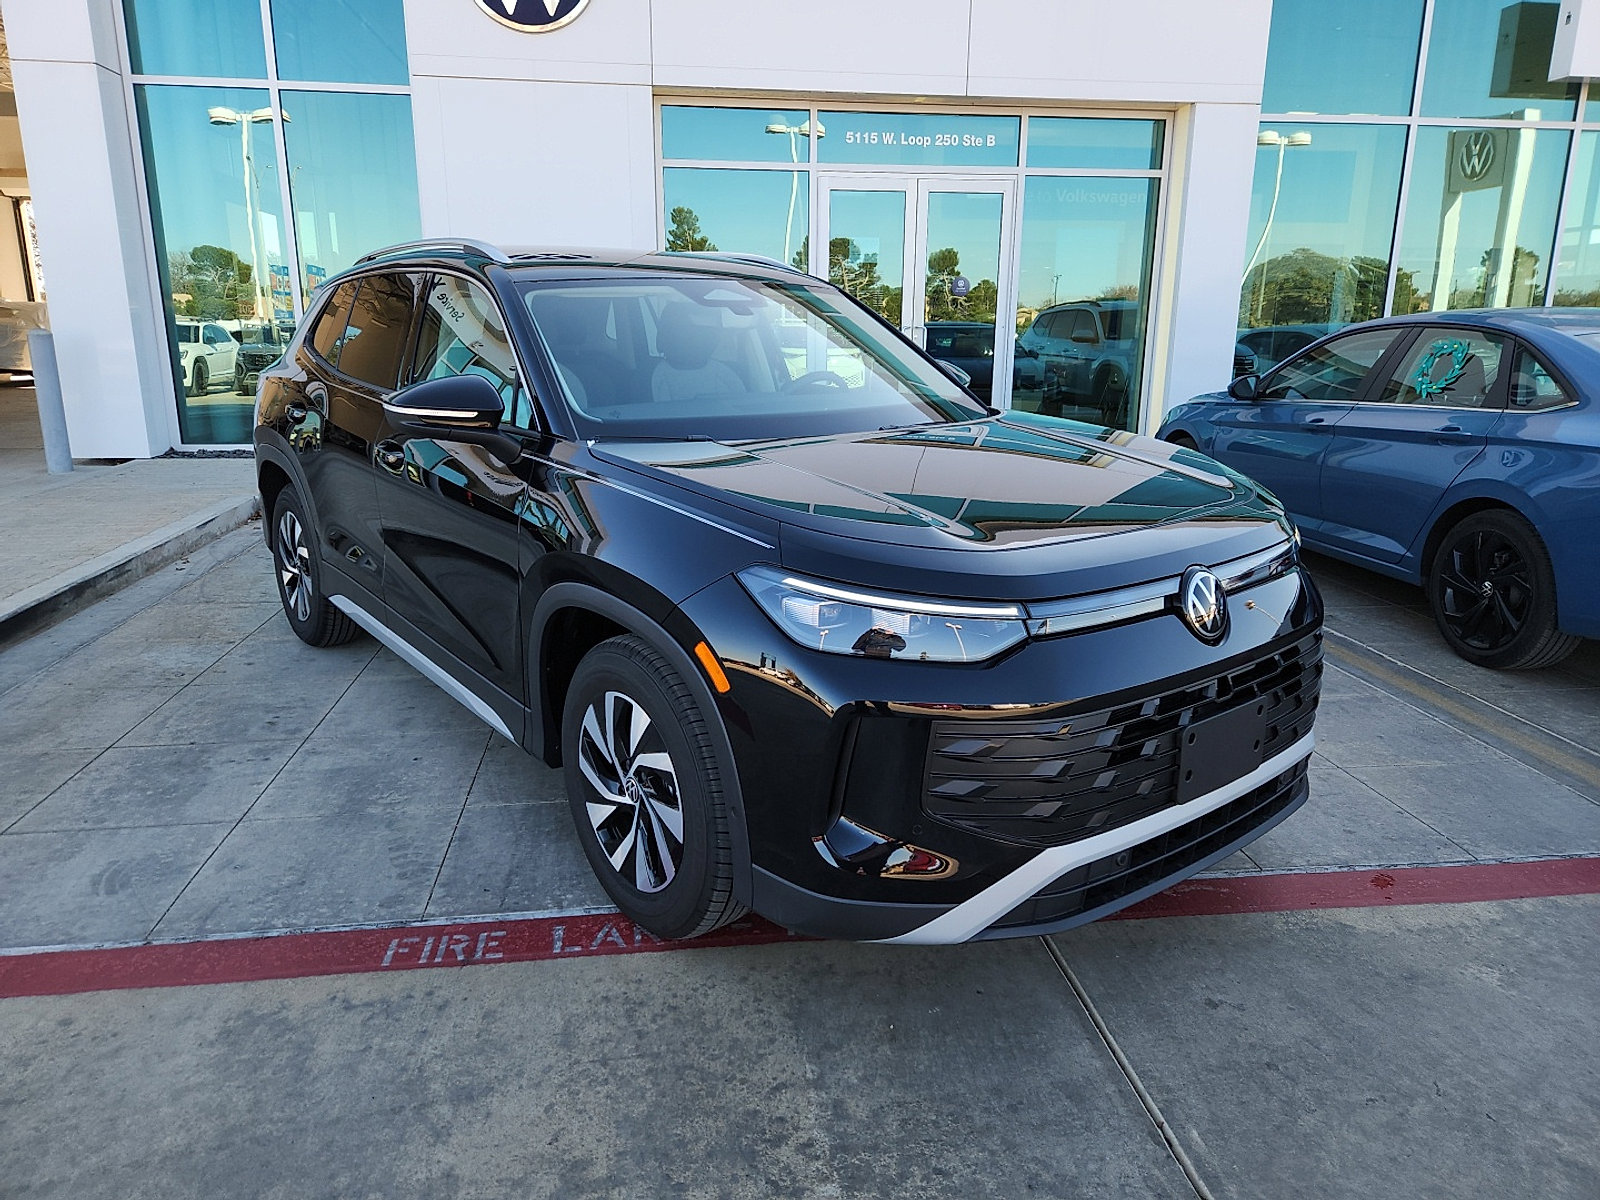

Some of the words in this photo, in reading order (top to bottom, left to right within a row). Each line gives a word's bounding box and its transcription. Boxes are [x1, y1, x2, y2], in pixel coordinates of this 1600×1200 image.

[845, 131, 878, 144] 5115
[882, 132, 897, 145] W.
[901, 132, 931, 147] Loop
[935, 134, 959, 146] 250
[962, 134, 983, 147] Ste
[986, 135, 996, 147] B
[1056, 188, 1145, 206] Volkswagen
[381, 931, 507, 966] FIRE
